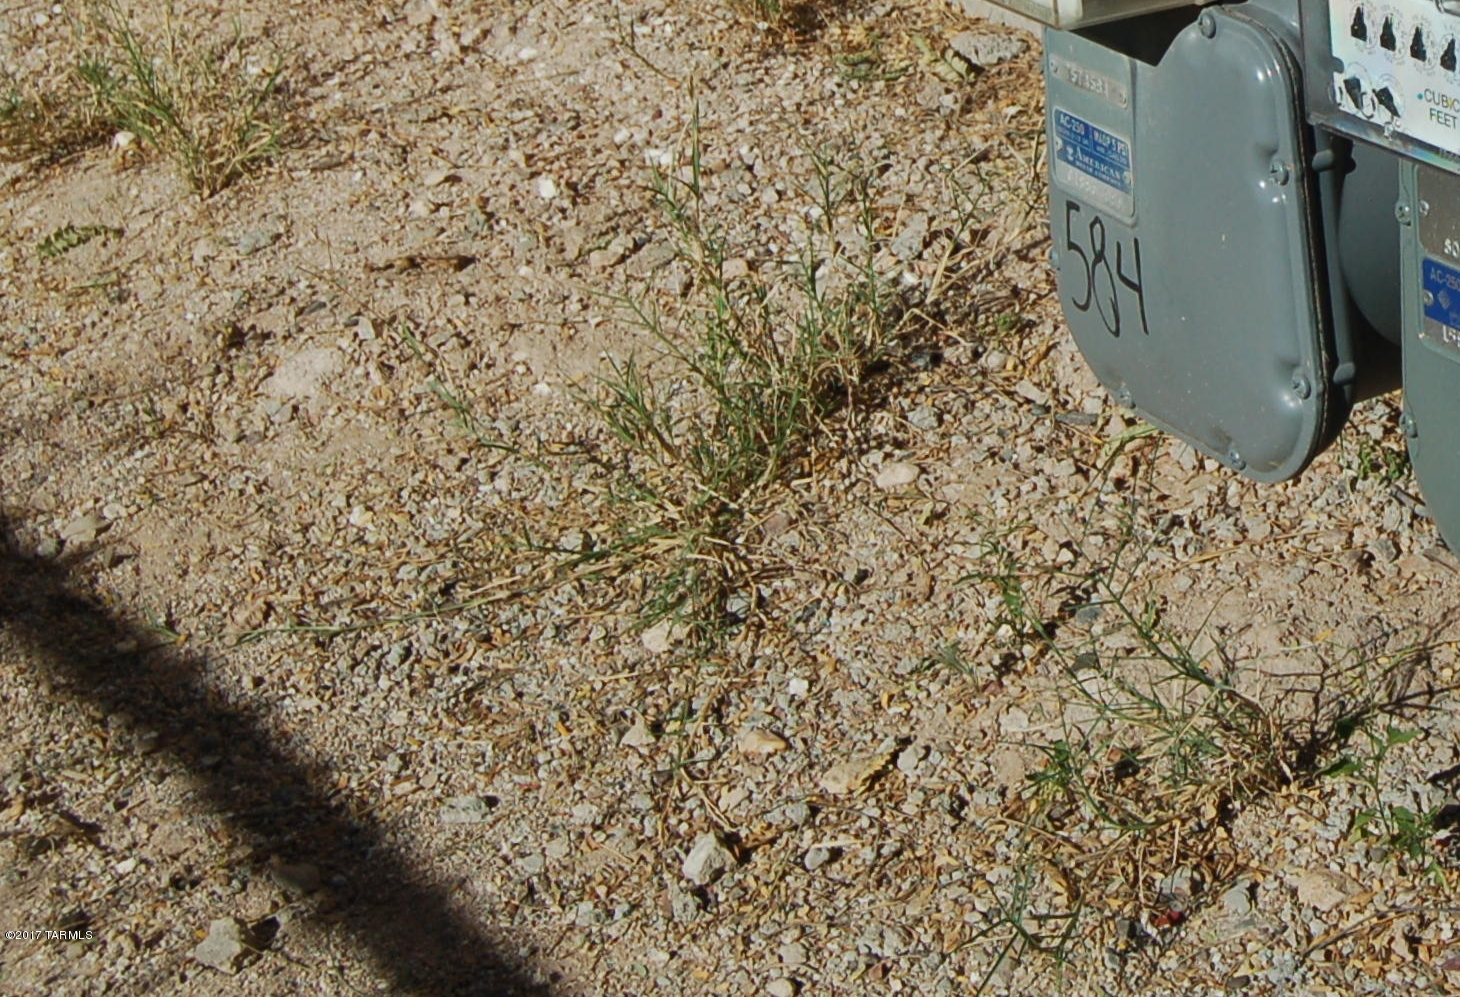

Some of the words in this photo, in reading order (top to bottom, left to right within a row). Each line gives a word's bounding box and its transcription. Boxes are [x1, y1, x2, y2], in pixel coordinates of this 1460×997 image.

[1424, 88, 1460, 113] CUBIC
[1429, 108, 1457, 129] FEET
[1066, 199, 1149, 338] 584
